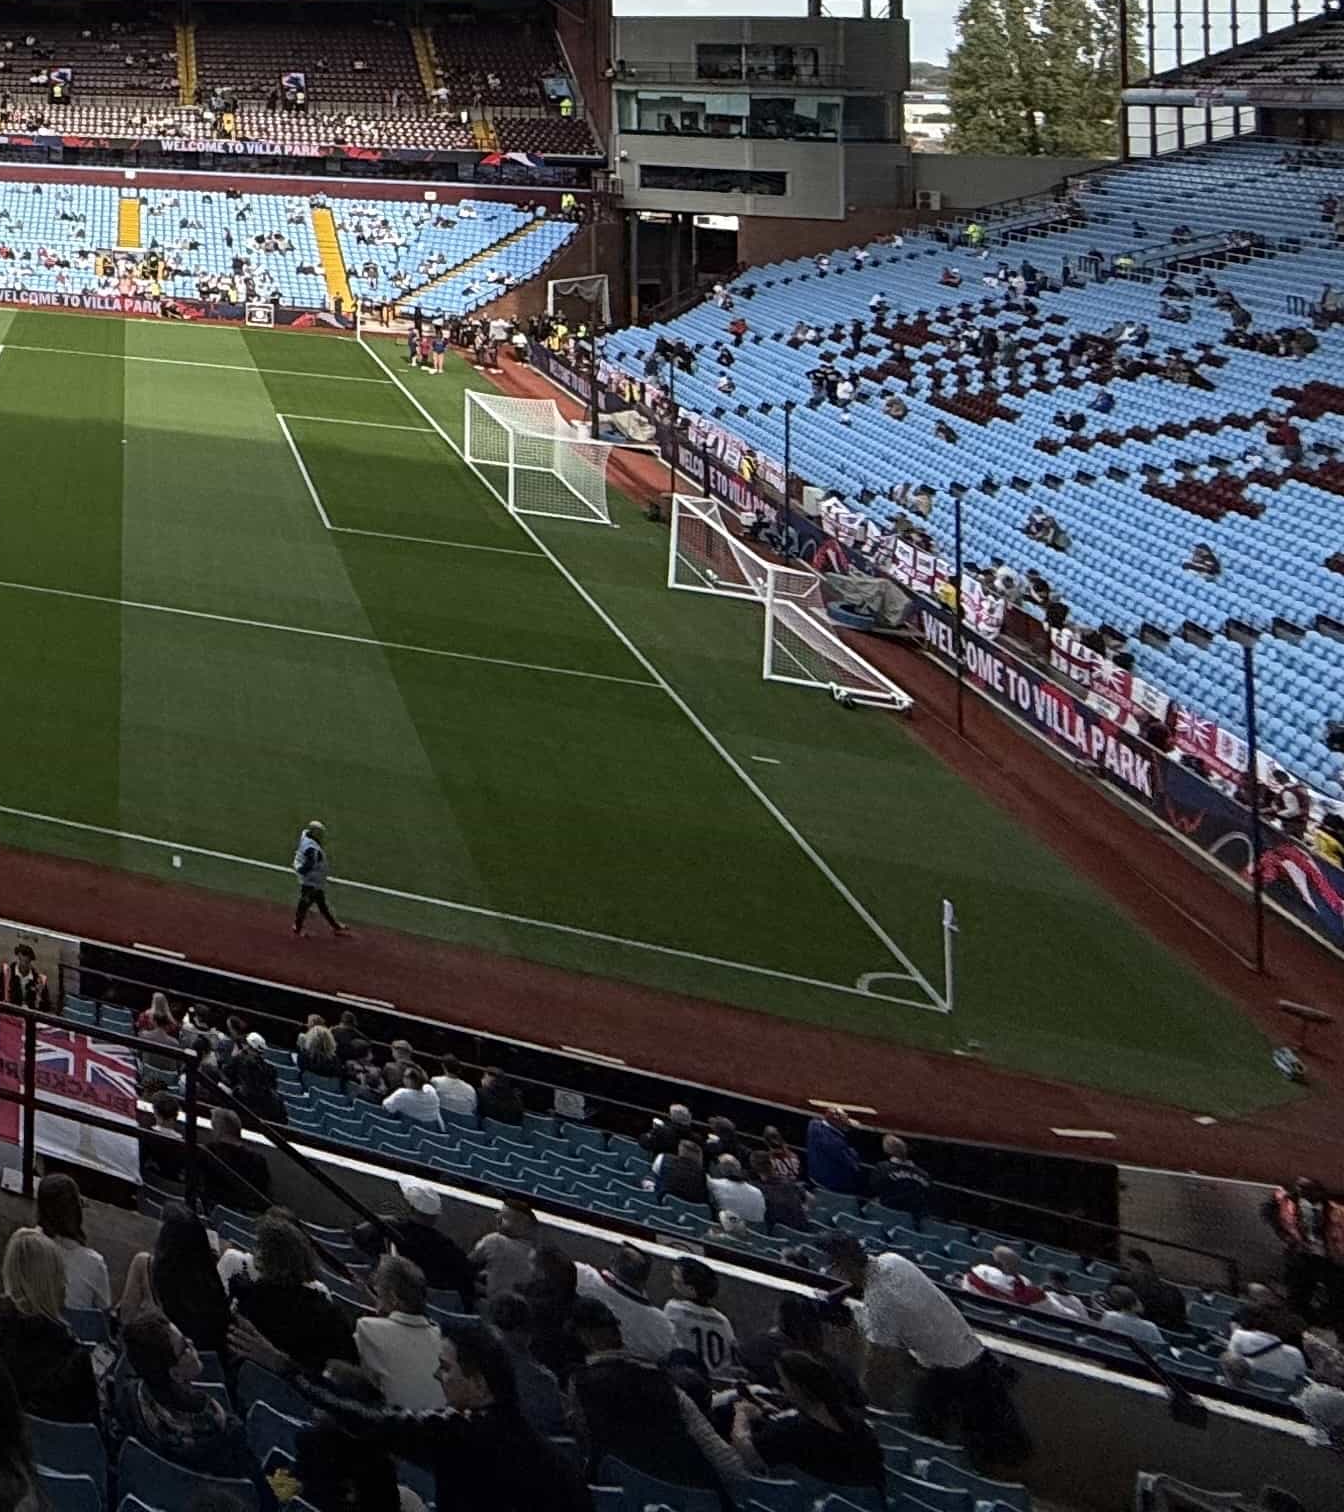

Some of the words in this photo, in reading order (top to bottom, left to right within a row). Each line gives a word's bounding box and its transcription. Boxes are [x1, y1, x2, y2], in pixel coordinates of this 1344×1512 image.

[160, 140, 225, 154] WELCOME
[227, 141, 244, 154] TO
[245, 142, 282, 156] VILLA
[283, 144, 321, 157] PARK
[62, 293, 80, 306] TO
[82, 294, 122, 311] VILLA
[124, 296, 162, 314] PARK
[678, 444, 716, 489] WELCOE
[716, 469, 728, 497] TO
[728, 478, 752, 512] VILLA
[1005, 667, 1031, 712] TO
[1033, 684, 1089, 754] VILLA
[1090, 725, 1153, 799] PARK
[691, 1326, 725, 1368] 10
